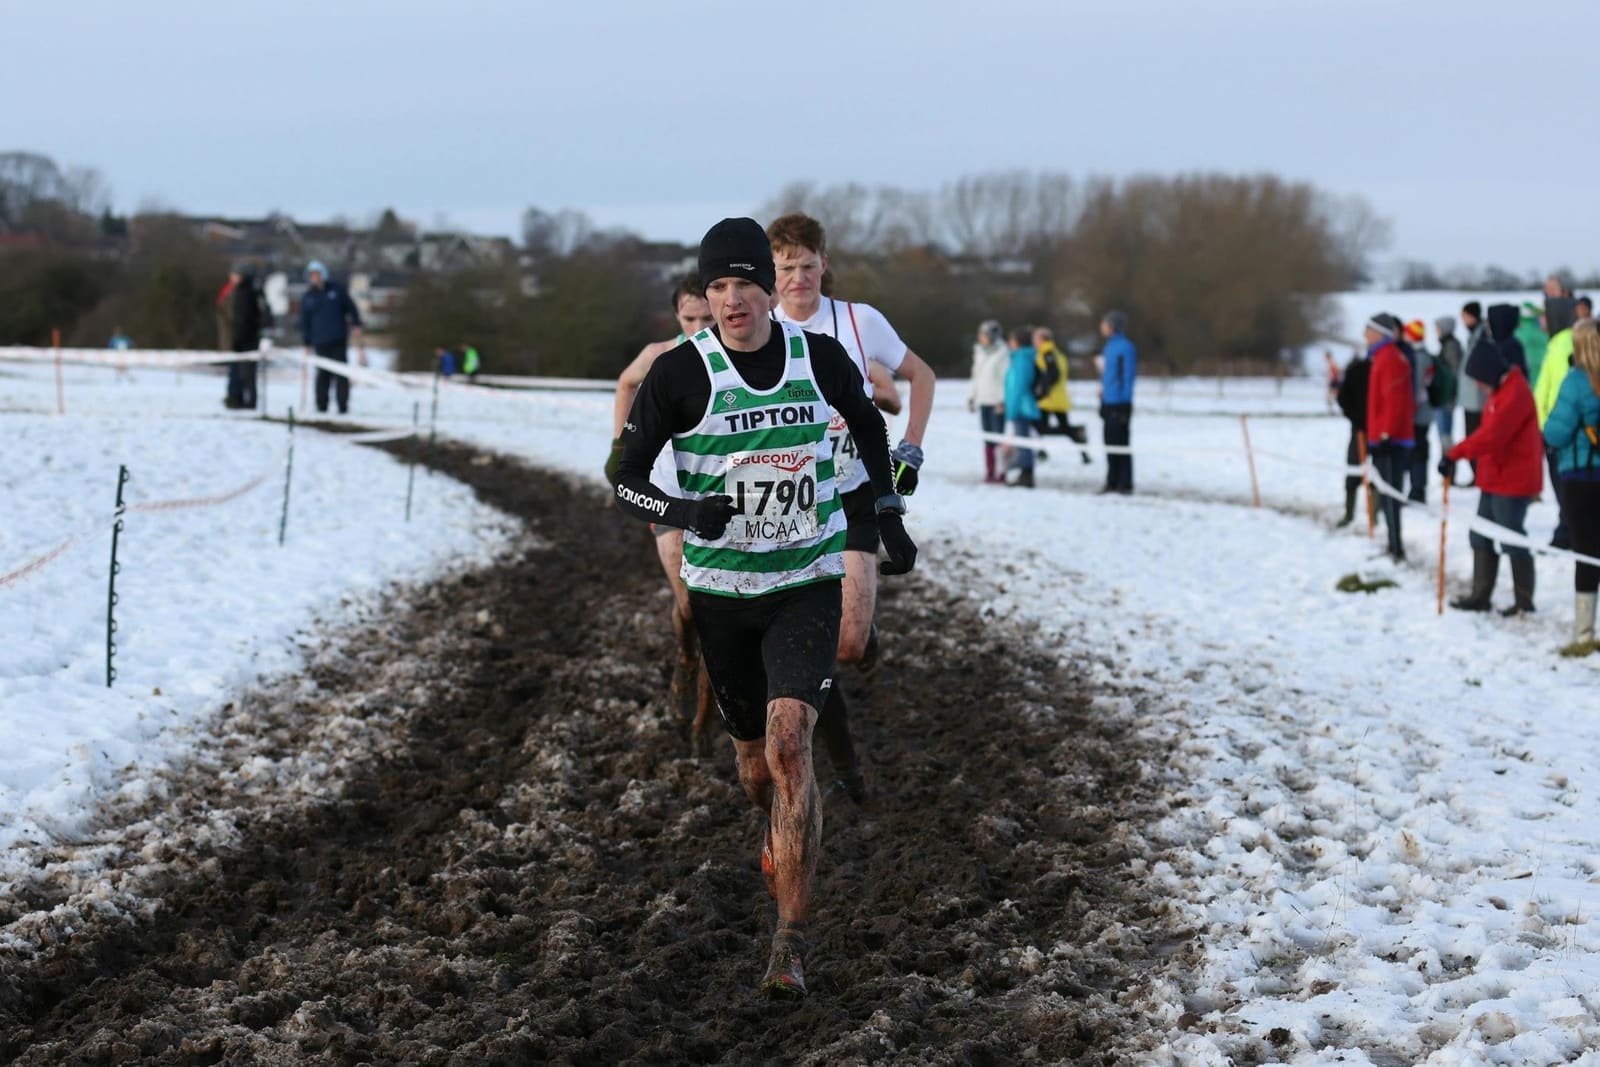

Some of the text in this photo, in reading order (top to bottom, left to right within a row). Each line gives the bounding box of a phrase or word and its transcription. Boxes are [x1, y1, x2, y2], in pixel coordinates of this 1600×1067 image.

[725, 406, 815, 432] TIPTON
[830, 433, 861, 460] 74
[732, 452, 799, 469] saucony
[616, 483, 670, 517] saucony
[736, 474, 815, 516] 1790
[745, 519, 800, 539] MCAA
